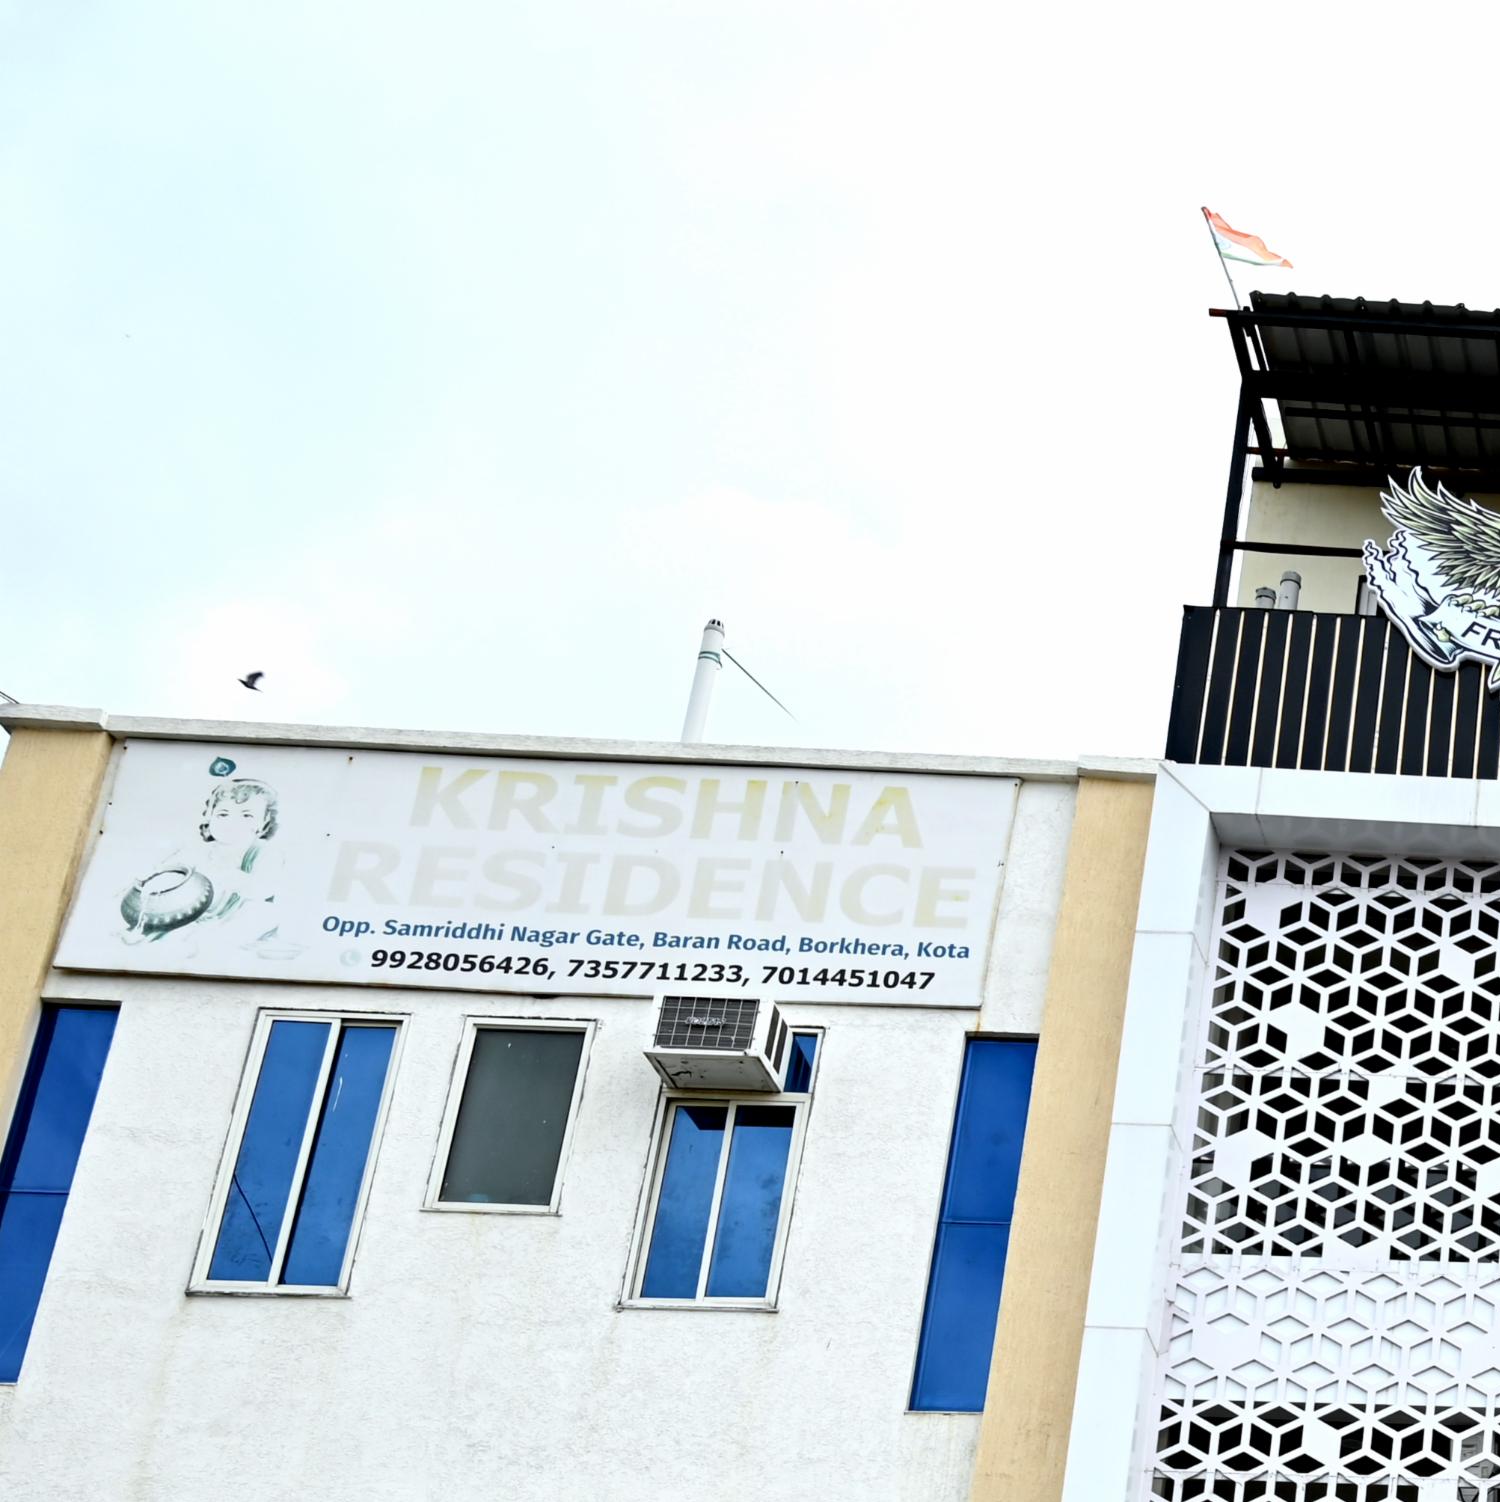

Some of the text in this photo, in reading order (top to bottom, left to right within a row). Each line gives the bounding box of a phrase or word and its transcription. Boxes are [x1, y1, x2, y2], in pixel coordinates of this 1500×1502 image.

[409, 765, 925, 850] KRISHNA
[326, 840, 977, 929] RESIDENCE
[322, 916, 971, 960] Opp. Samriddhi Nagar Gate, Baran Road, Borkhera, Kota
[371, 948, 936, 991] 9928056426, 7357711233, 7014451047
